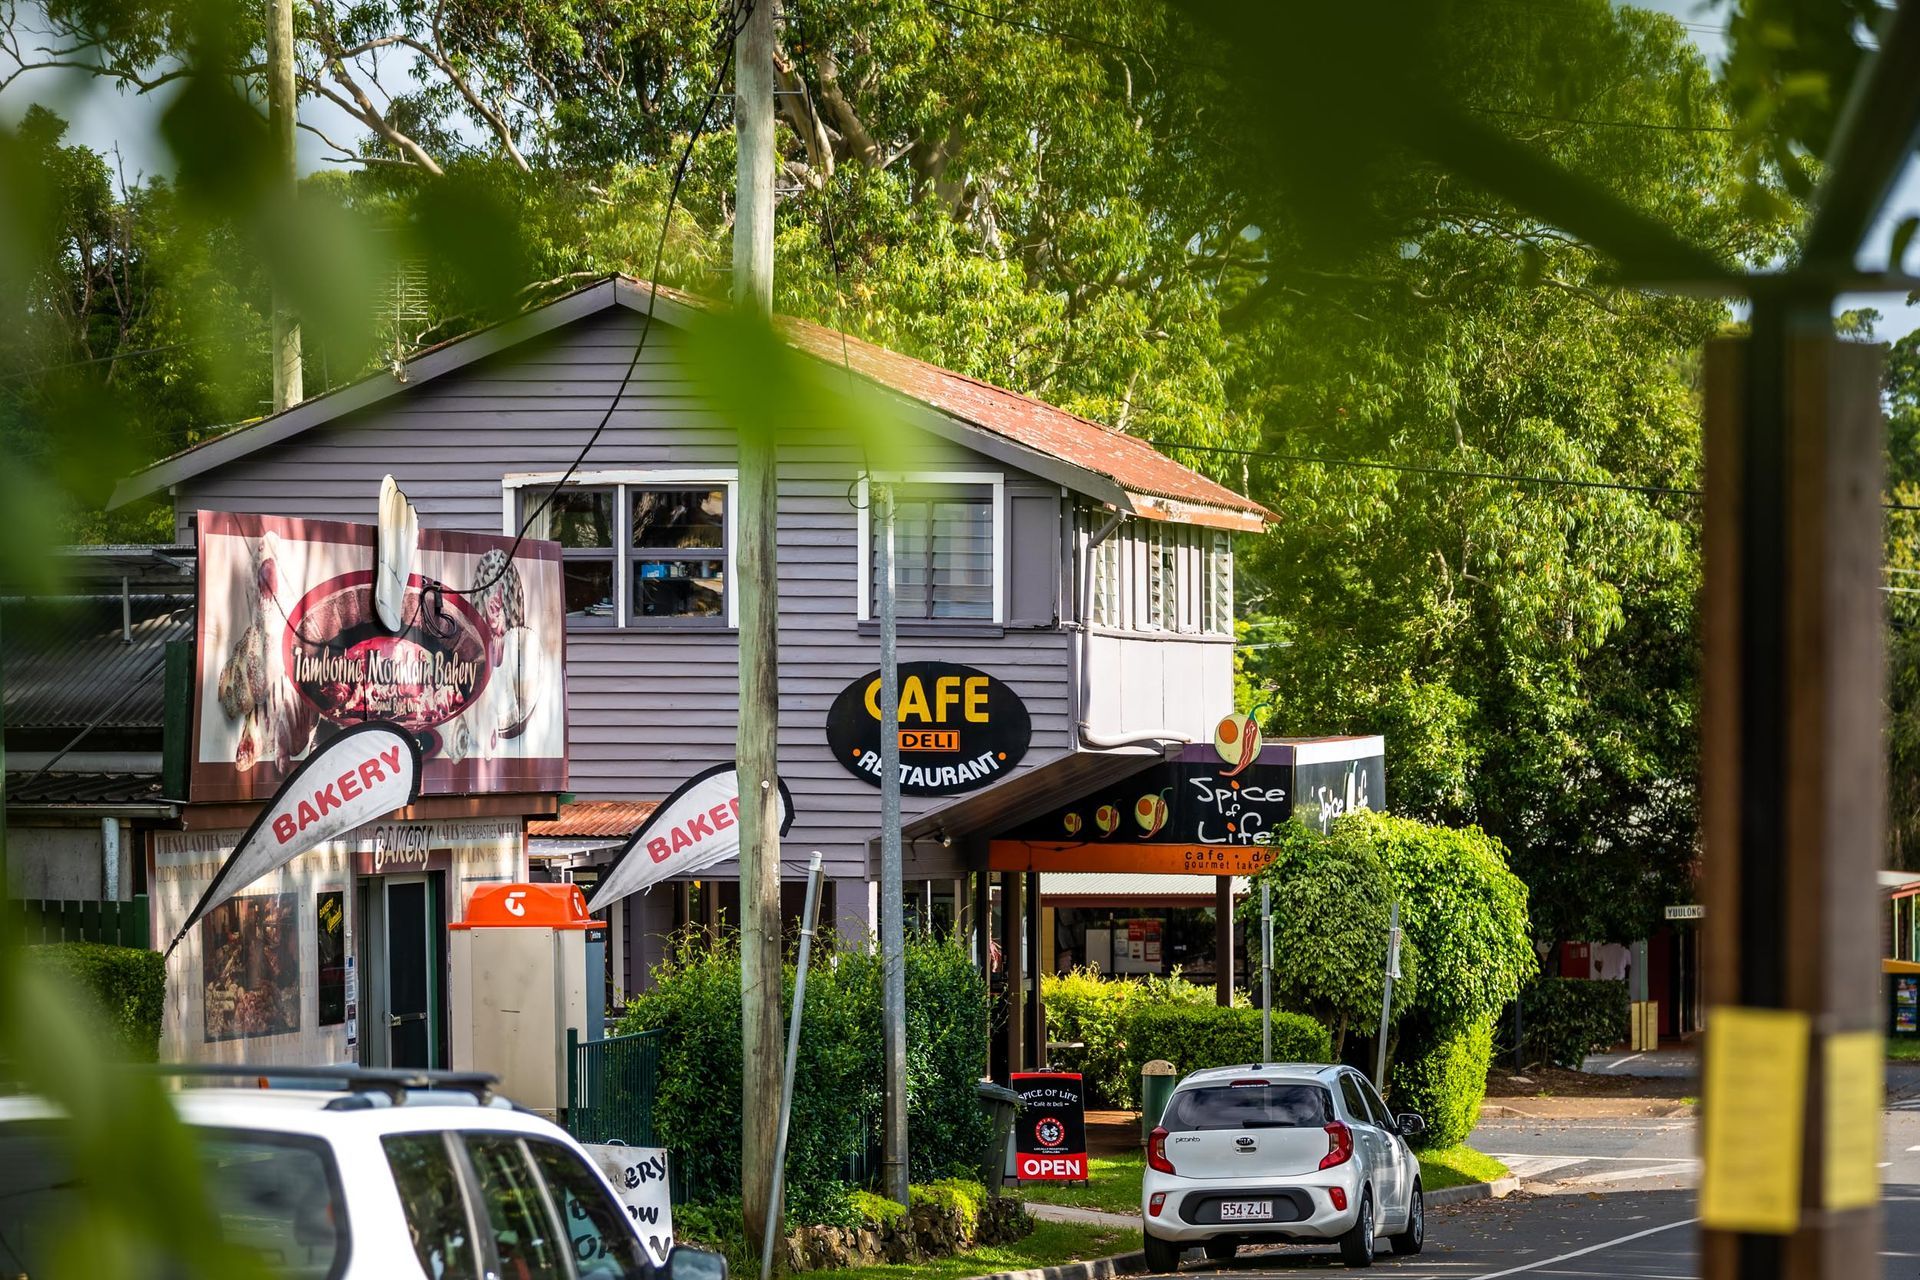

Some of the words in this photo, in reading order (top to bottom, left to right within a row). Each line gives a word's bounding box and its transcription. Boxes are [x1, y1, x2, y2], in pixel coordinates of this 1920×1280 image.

[366, 649, 433, 686] Mountain
[433, 651, 478, 693] Bakery
[863, 675, 990, 723] CAFE
[902, 734, 953, 748] DELI
[857, 750, 1000, 787] RETAURANT
[272, 745, 402, 844] BAKERY
[1189, 777, 1286, 814] Spice
[1225, 803, 1241, 817] of
[1317, 786, 1344, 835] Spice
[646, 797, 740, 864] BAKE
[1198, 812, 1272, 845] Life
[1184, 860, 1230, 870] gourmet
[1185, 850, 1224, 860] cafe
[1044, 1088, 1058, 1097] OF
[1059, 1090, 1079, 1103] LIFE
[1175, 1136, 1201, 1144] picanto
[1023, 1159, 1081, 1176] OPEN
